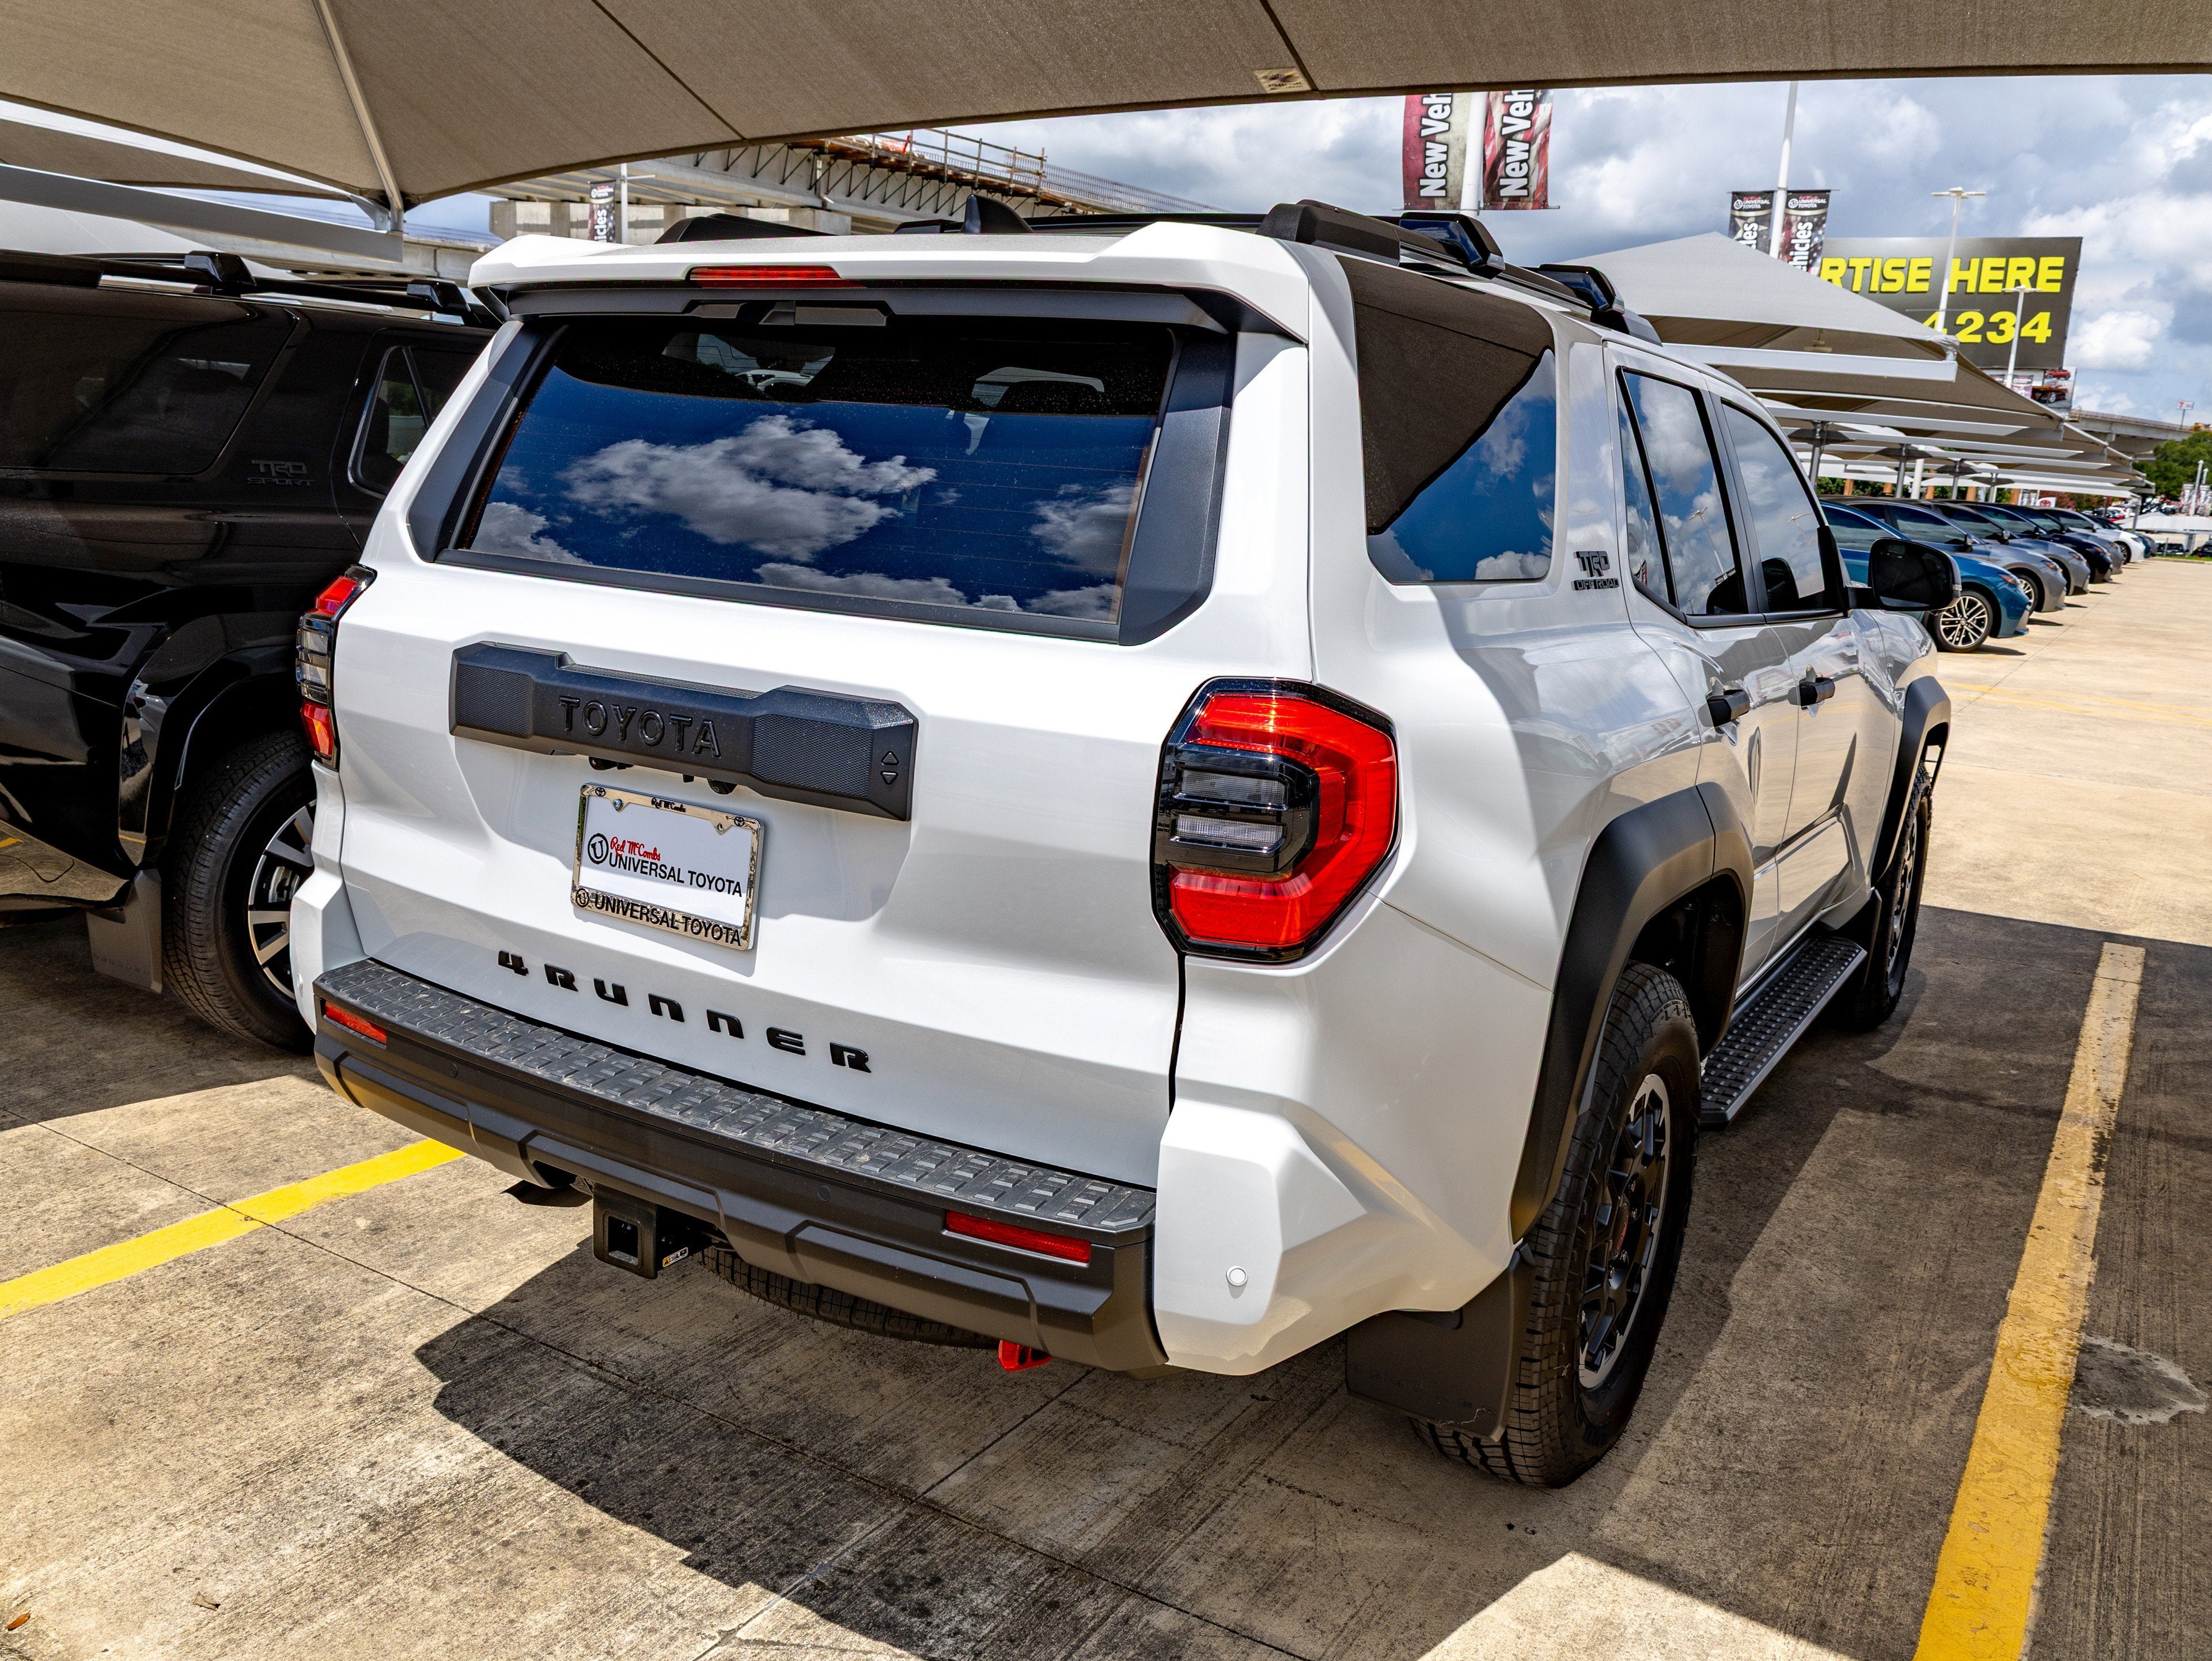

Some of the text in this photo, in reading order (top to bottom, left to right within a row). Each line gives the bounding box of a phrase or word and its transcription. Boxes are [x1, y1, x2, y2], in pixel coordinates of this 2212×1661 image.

[1419, 93, 1452, 196] New Veh
[1499, 90, 1535, 196] New Veh
[594, 209, 607, 242] icles
[1738, 222, 1759, 249] les
[1820, 257, 2065, 293] RTISE HERE
[247, 477, 316, 486] SPORT
[251, 460, 307, 477] TRD
[1573, 551, 1610, 577] TRD
[558, 695, 721, 758] TOYOTA
[610, 837, 661, 861] Red McCombs
[609, 852, 743, 898] UNIVERSAL TOYOTA
[594, 894, 742, 946] UNIVERSAL TOYOTA
[497, 949, 872, 1073] 4RUNNER
